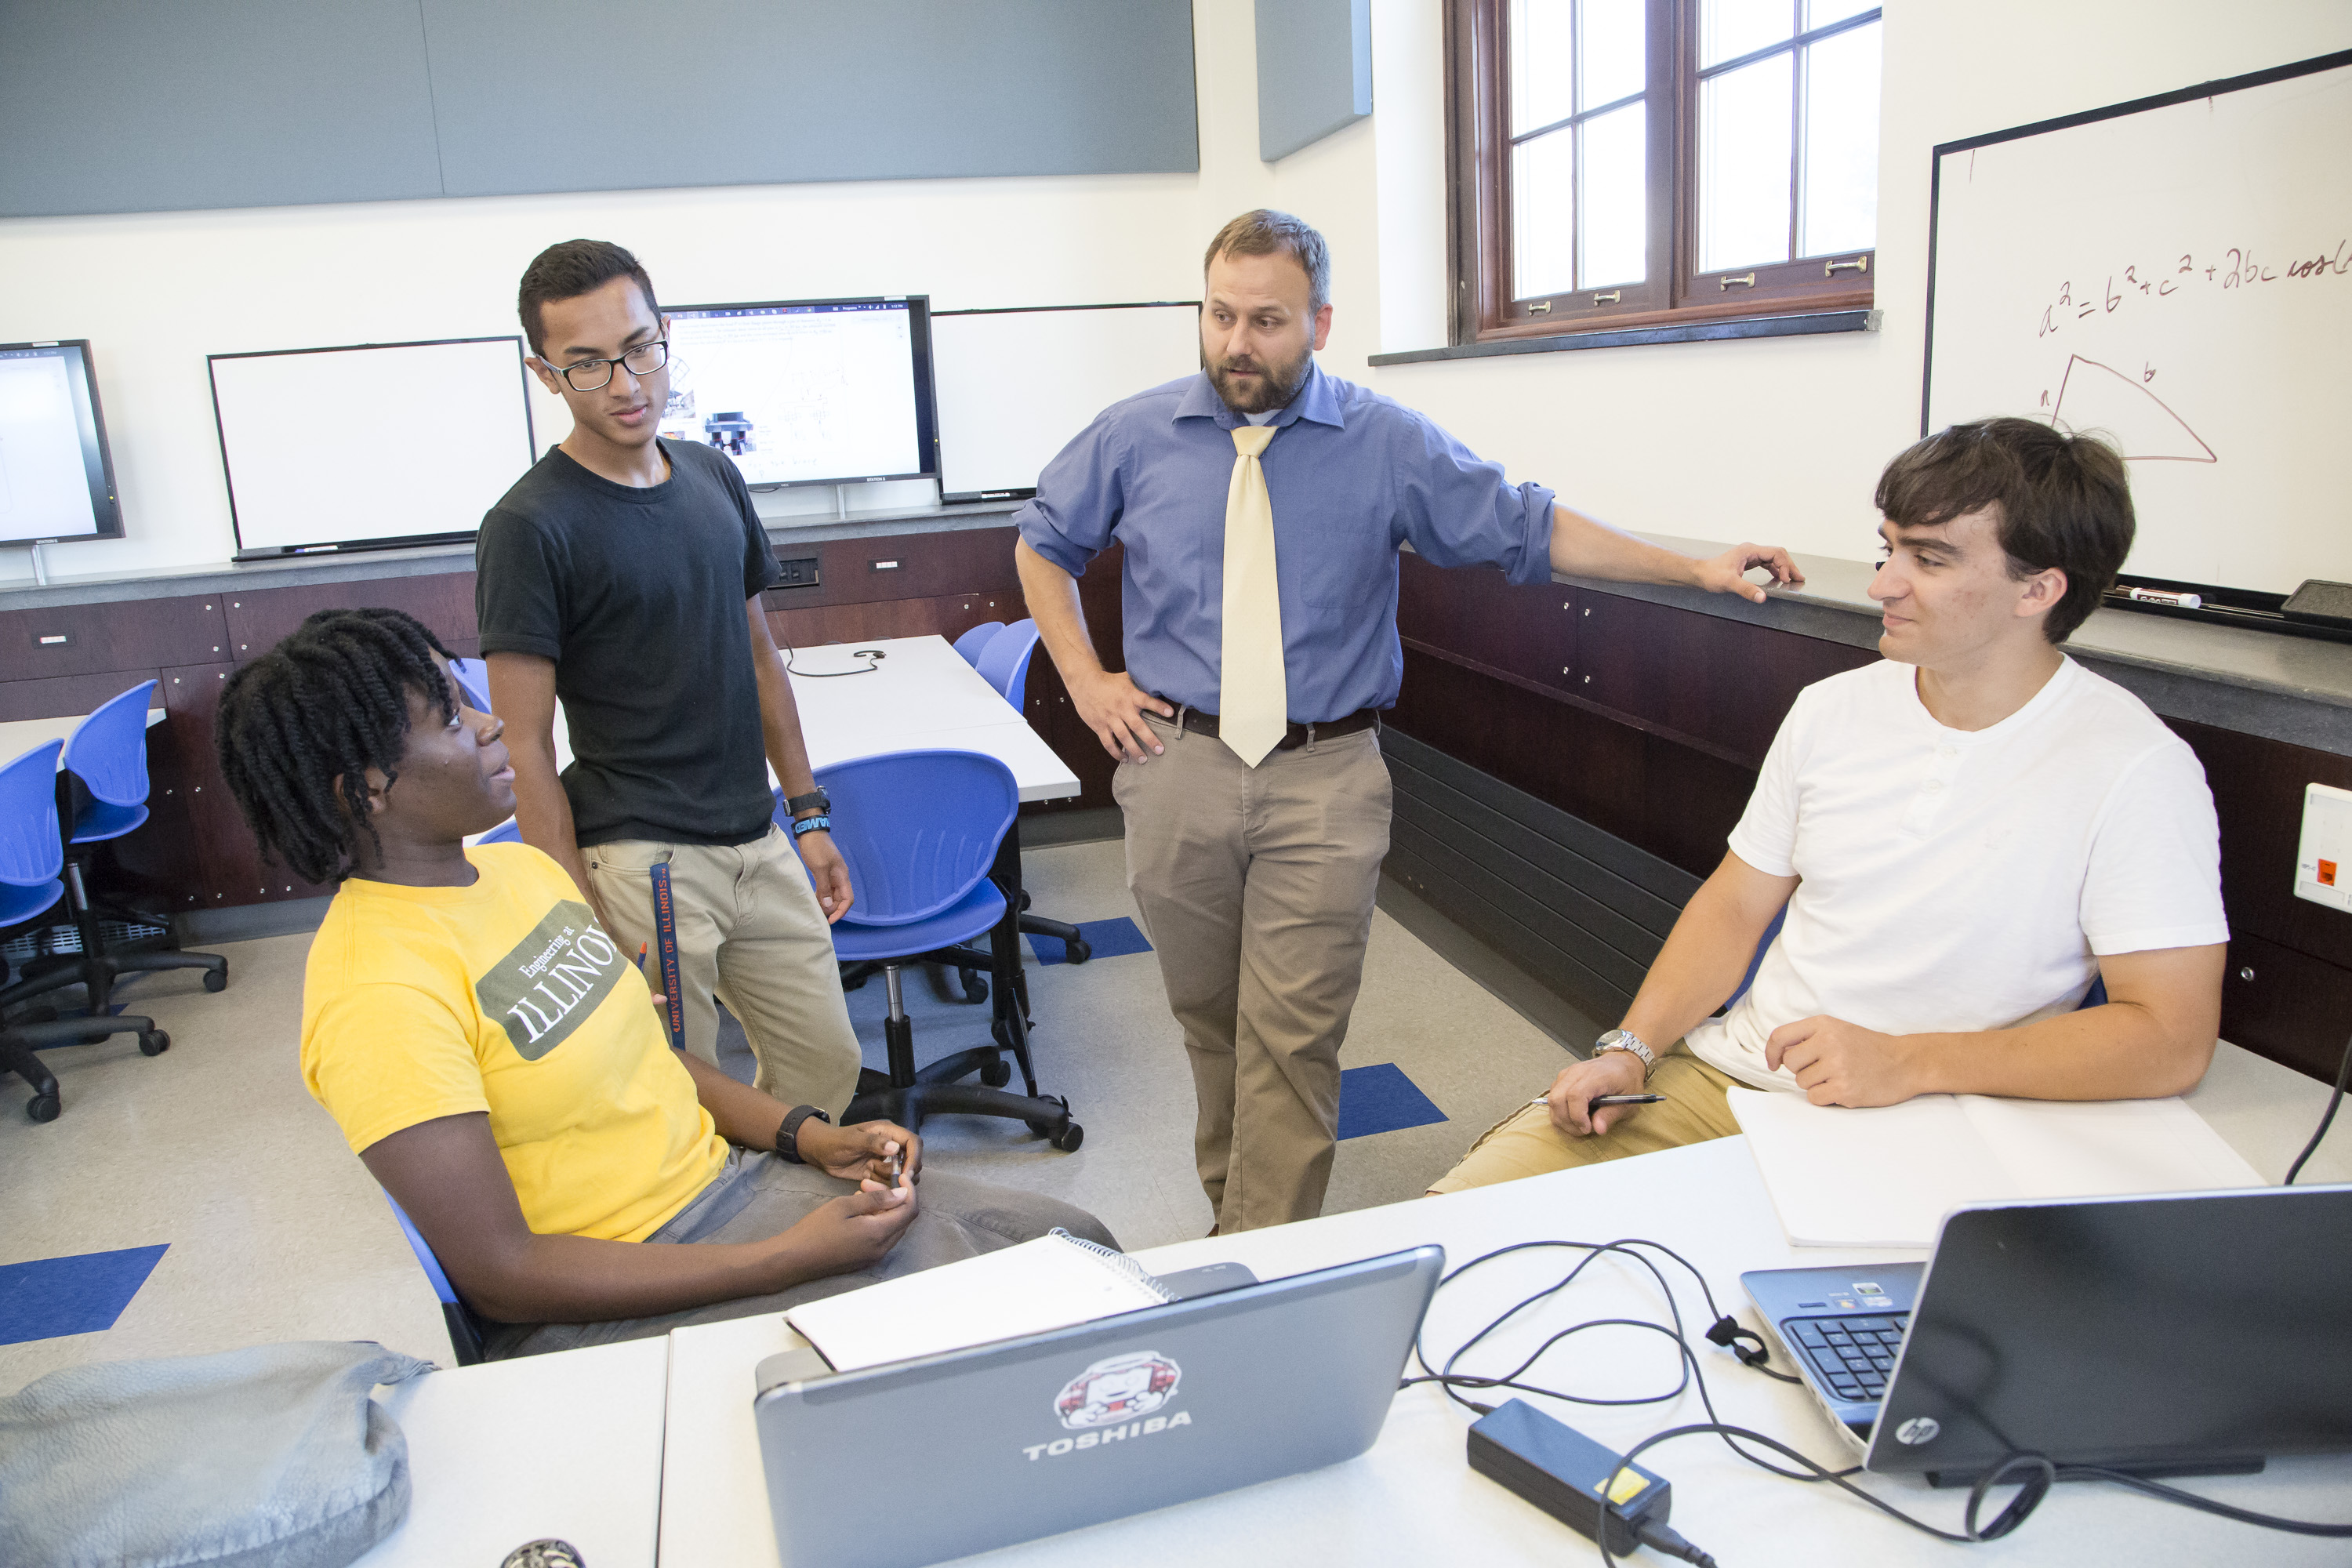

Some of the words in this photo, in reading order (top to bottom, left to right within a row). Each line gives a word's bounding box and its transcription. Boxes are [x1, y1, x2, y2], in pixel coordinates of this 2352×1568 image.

[518, 935, 572, 979] Engineering
[563, 925, 575, 937] at
[664, 938, 673, 953] OF
[506, 916, 618, 1044] ILLINOI
[667, 958, 681, 1033] UNIVERSITY
[1022, 1410, 1192, 1461] TOSHIBA
